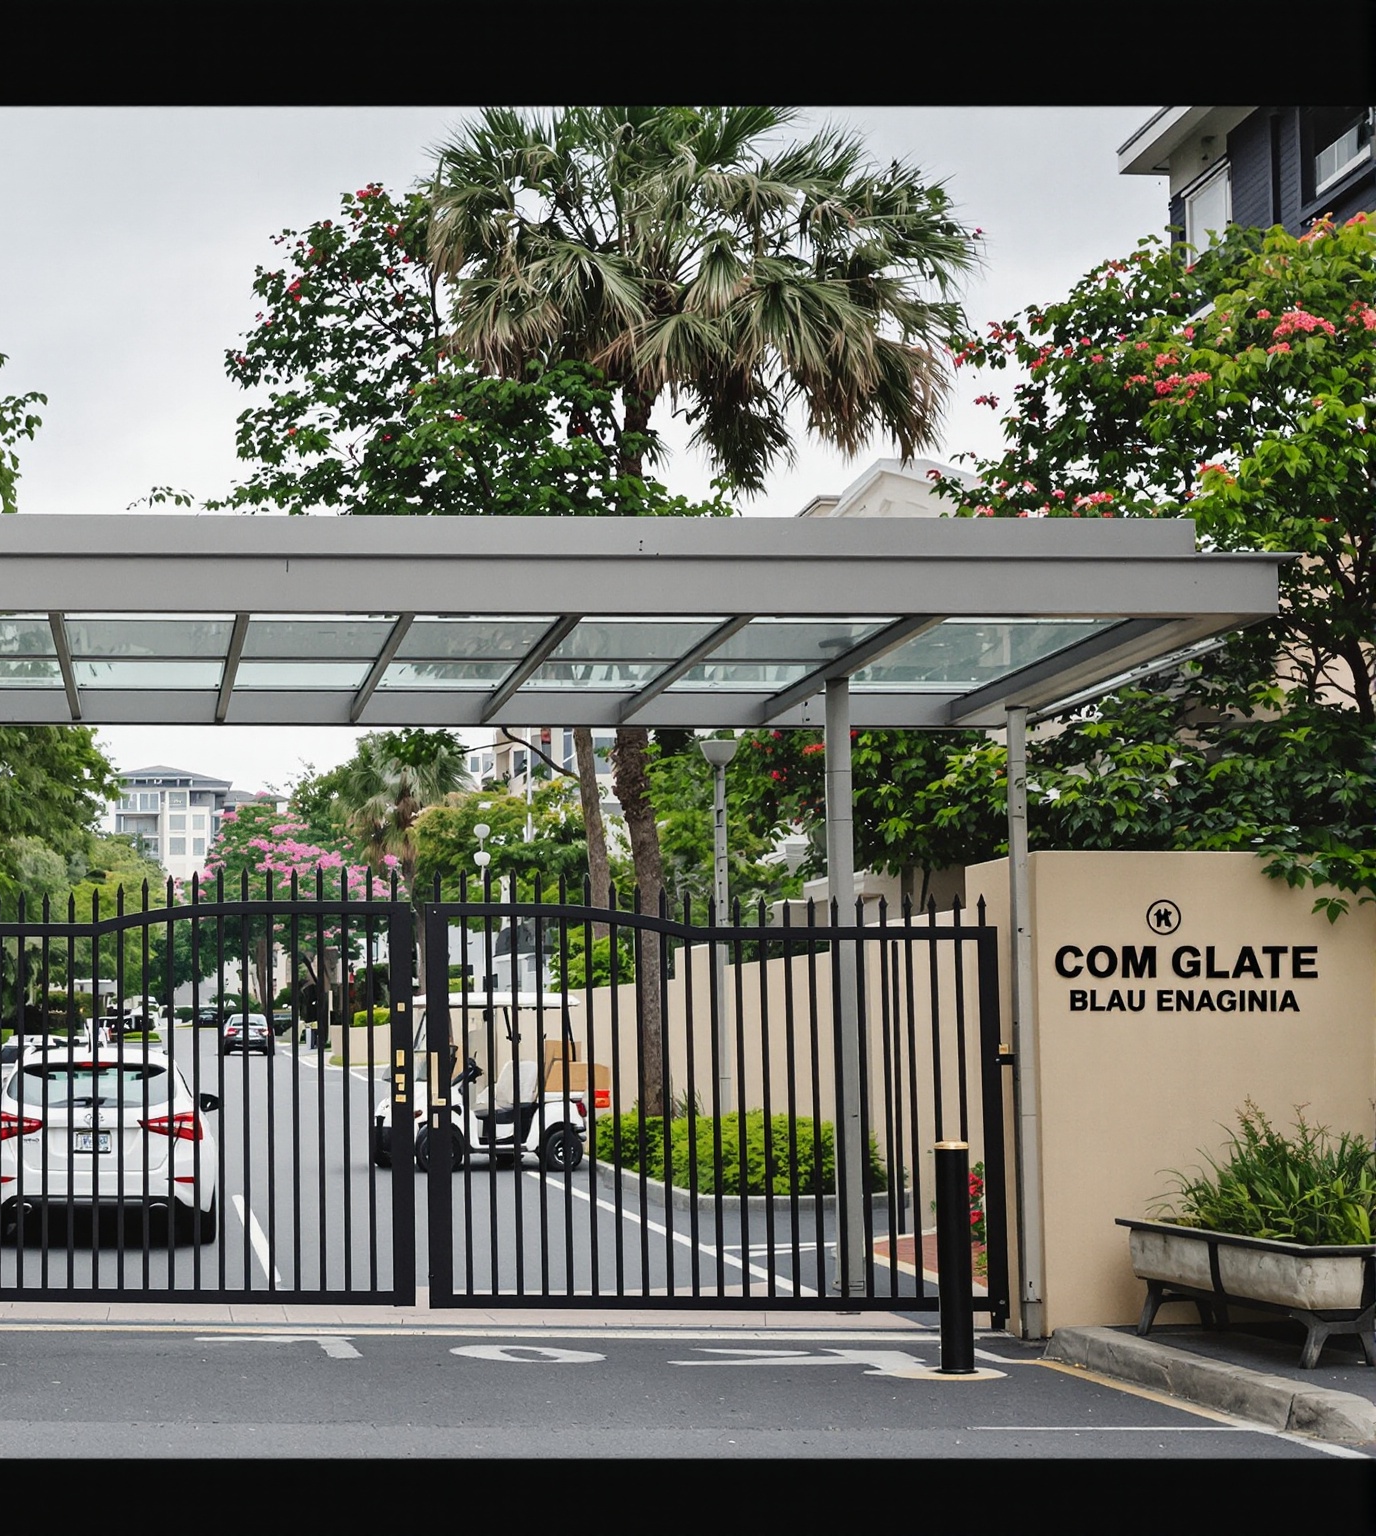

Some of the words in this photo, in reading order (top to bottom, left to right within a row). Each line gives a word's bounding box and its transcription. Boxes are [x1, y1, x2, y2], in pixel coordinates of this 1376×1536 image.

[1054, 944, 1157, 980] COM
[1171, 944, 1319, 980] GLATE
[1069, 989, 1146, 1013] BLAU
[1156, 989, 1301, 1013] ENAGINIA
